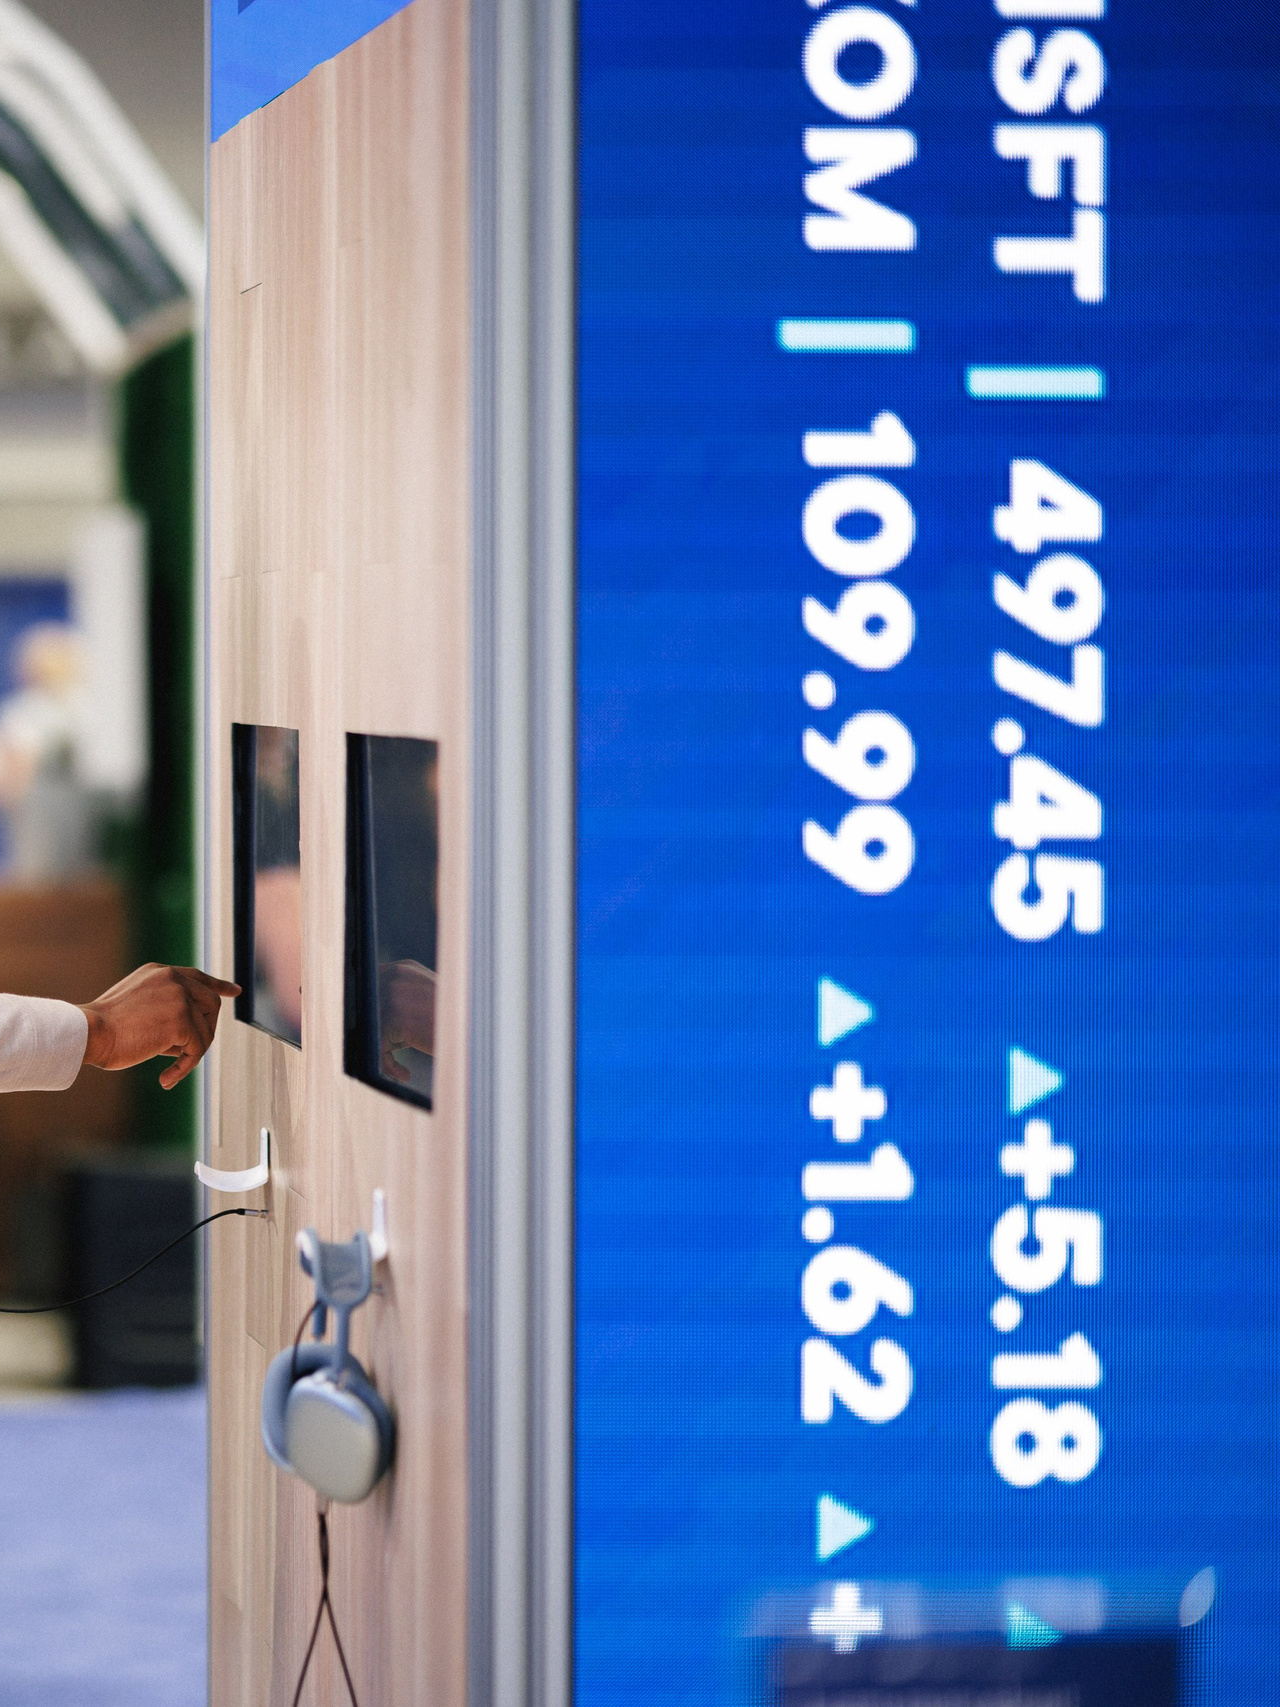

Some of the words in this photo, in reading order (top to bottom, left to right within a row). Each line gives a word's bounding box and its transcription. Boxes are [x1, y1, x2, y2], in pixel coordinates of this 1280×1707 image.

[800, 0, 919, 252] OM
[992, 0, 1106, 304] SFT
[800, 410, 918, 897] 109.99
[991, 457, 1106, 943] 497.45
[799, 1060, 917, 1425] +1.62
[989, 1117, 1106, 1488] +5.18
